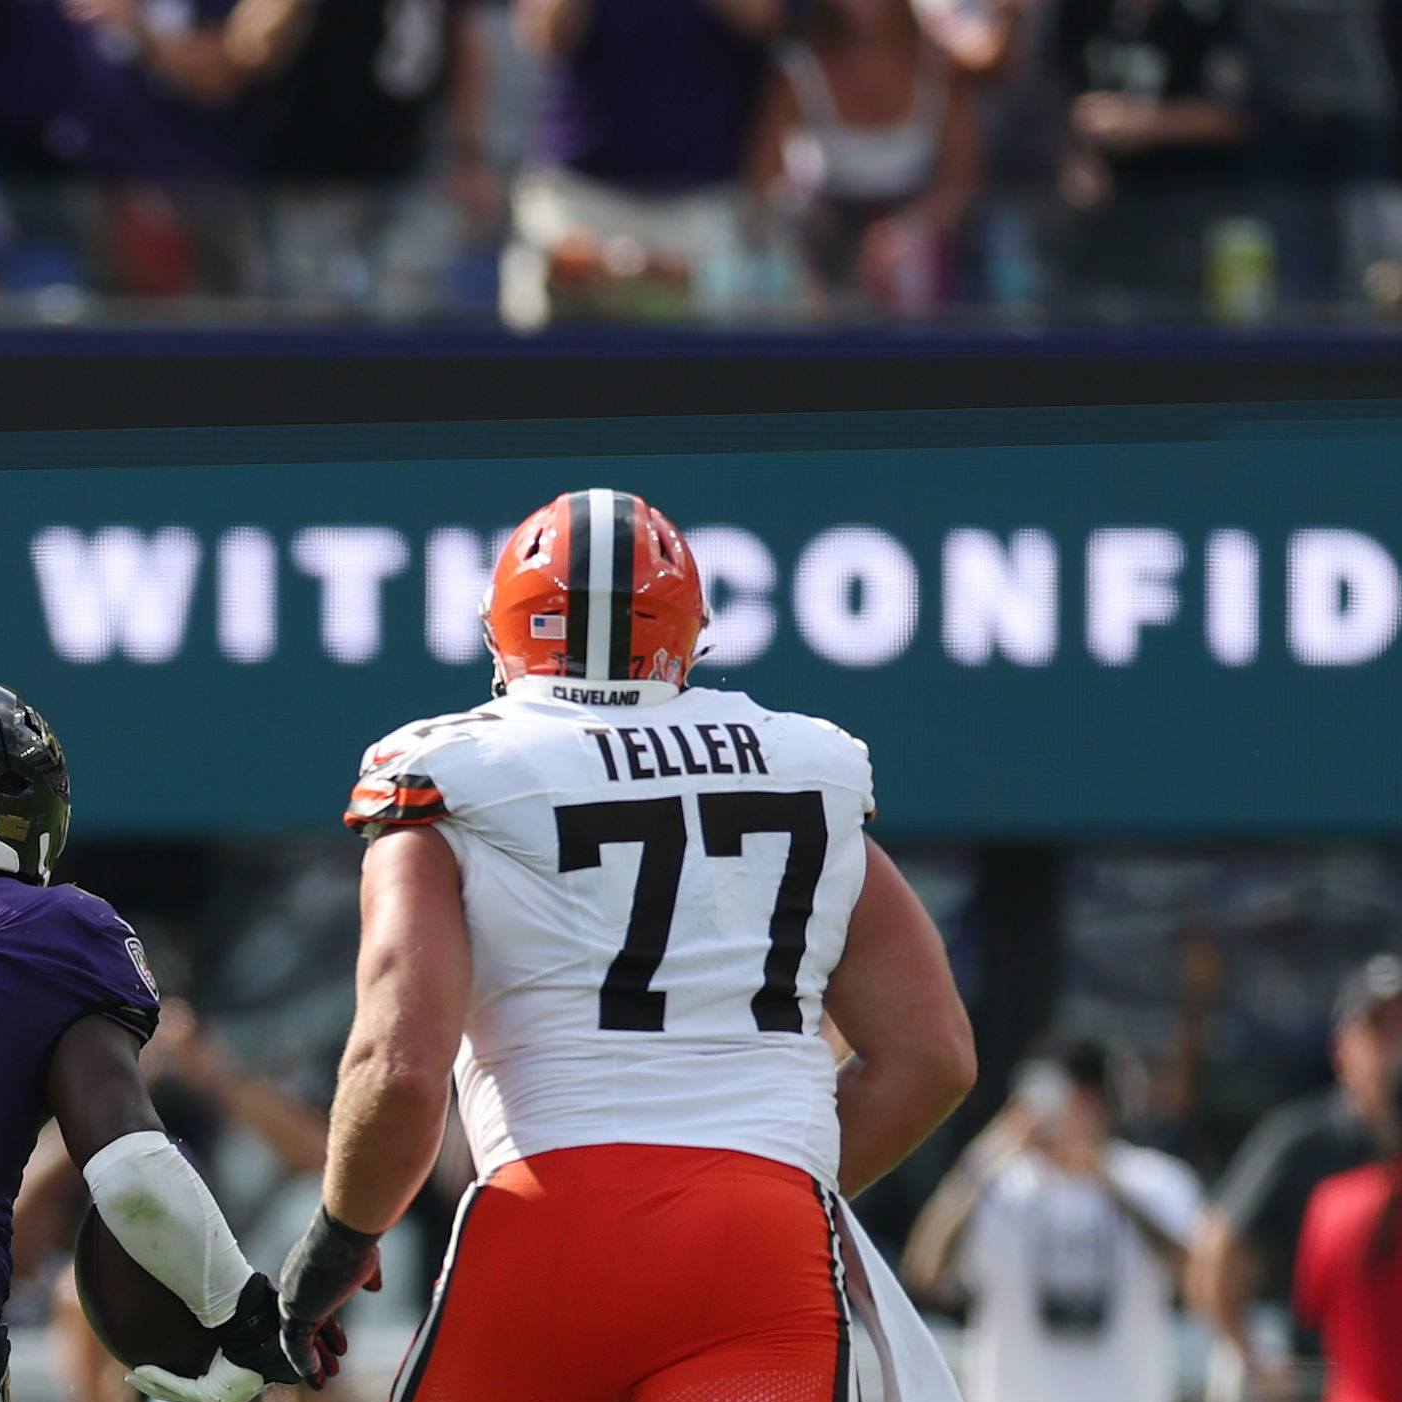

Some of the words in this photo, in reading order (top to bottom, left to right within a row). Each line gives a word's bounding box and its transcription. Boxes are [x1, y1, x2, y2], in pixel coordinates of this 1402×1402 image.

[683, 523, 1402, 668] CONFID
[551, 686, 640, 706] CLEVELAND
[584, 722, 770, 782] TELLER
[554, 790, 829, 1035] 77
